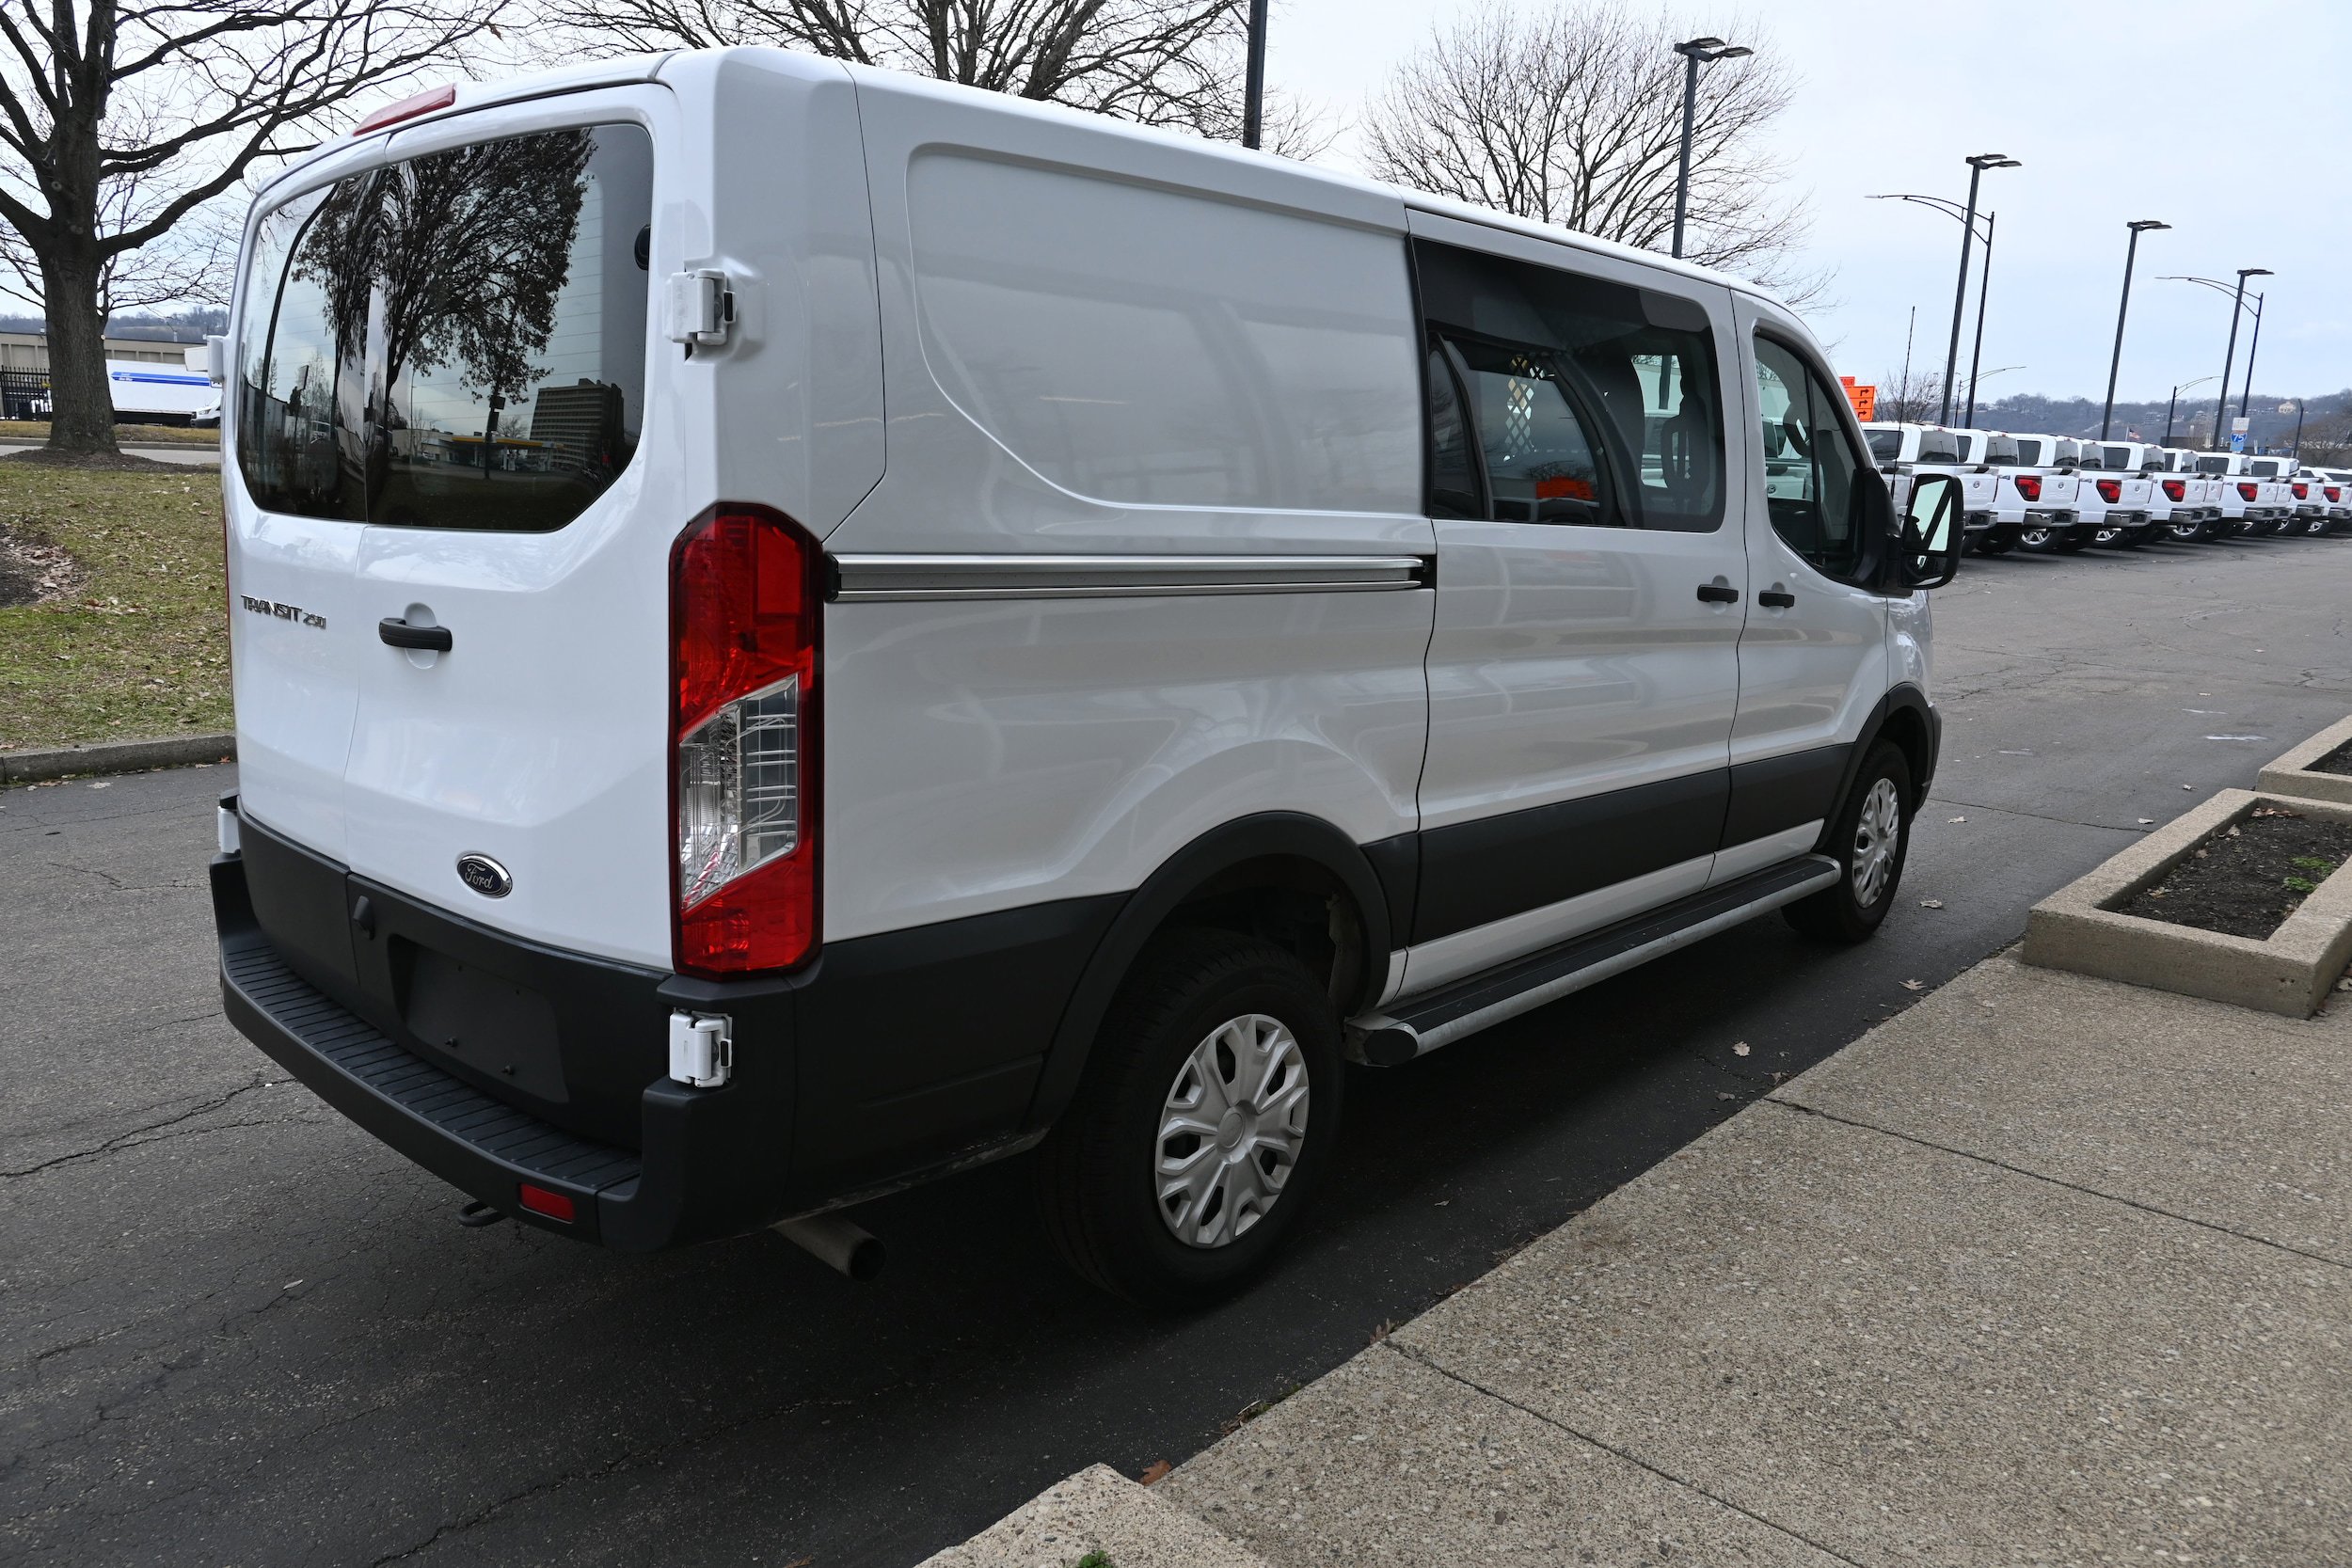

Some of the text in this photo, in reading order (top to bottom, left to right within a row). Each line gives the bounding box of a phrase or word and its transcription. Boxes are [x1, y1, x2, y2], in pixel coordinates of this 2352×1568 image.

[2233, 434, 2245, 442] 75
[241, 594, 326, 630] TRANSIT 250
[465, 863, 493, 889] Ford
